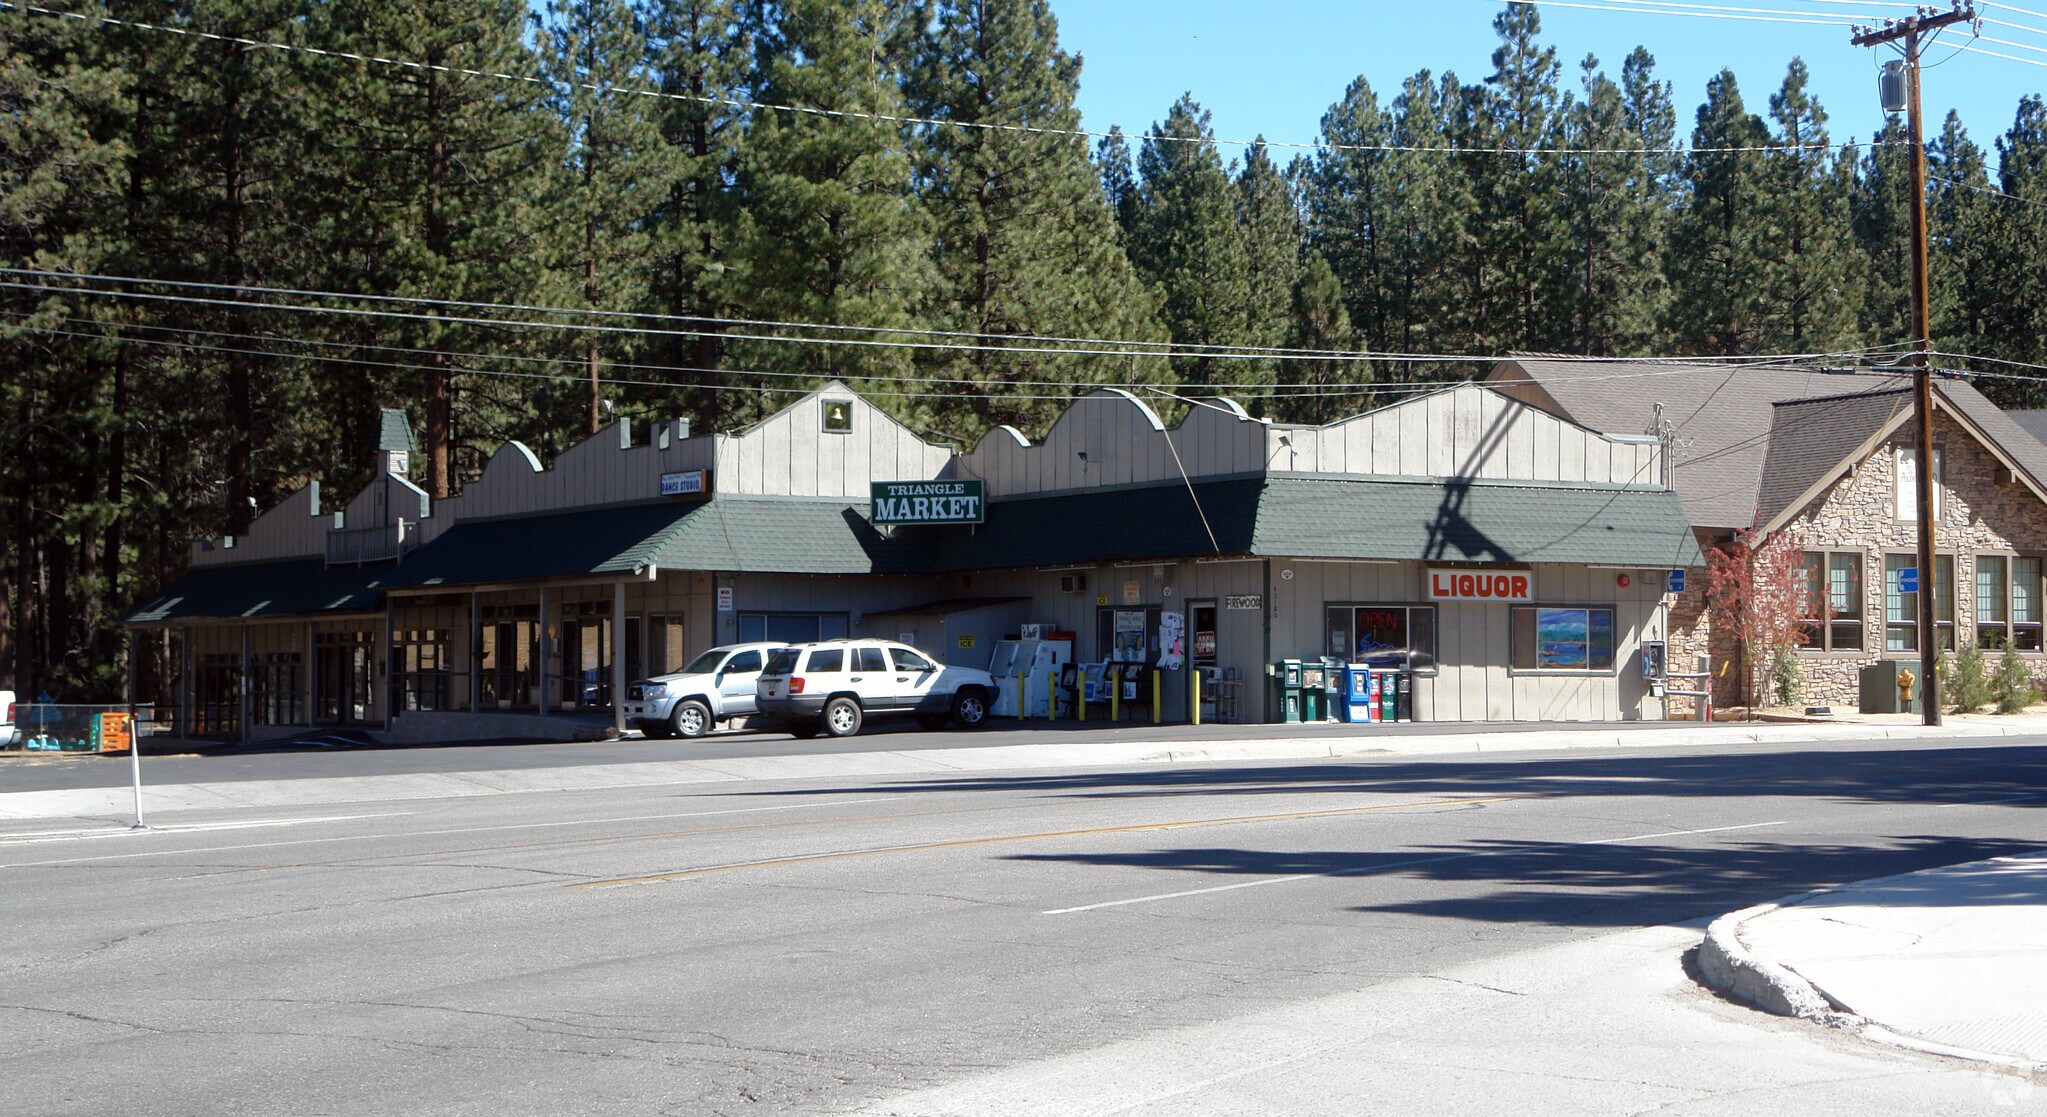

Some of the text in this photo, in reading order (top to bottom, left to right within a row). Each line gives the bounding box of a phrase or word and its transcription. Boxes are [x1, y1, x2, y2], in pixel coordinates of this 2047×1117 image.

[661, 480, 700, 492] DANCE STUDIO
[888, 484, 964, 496] TRIANGLE
[875, 496, 978, 521] MARKET
[1433, 574, 1528, 598] LIQUOR
[1226, 597, 1261, 608] FIREWOOD
[1360, 611, 1397, 629] OPEN
